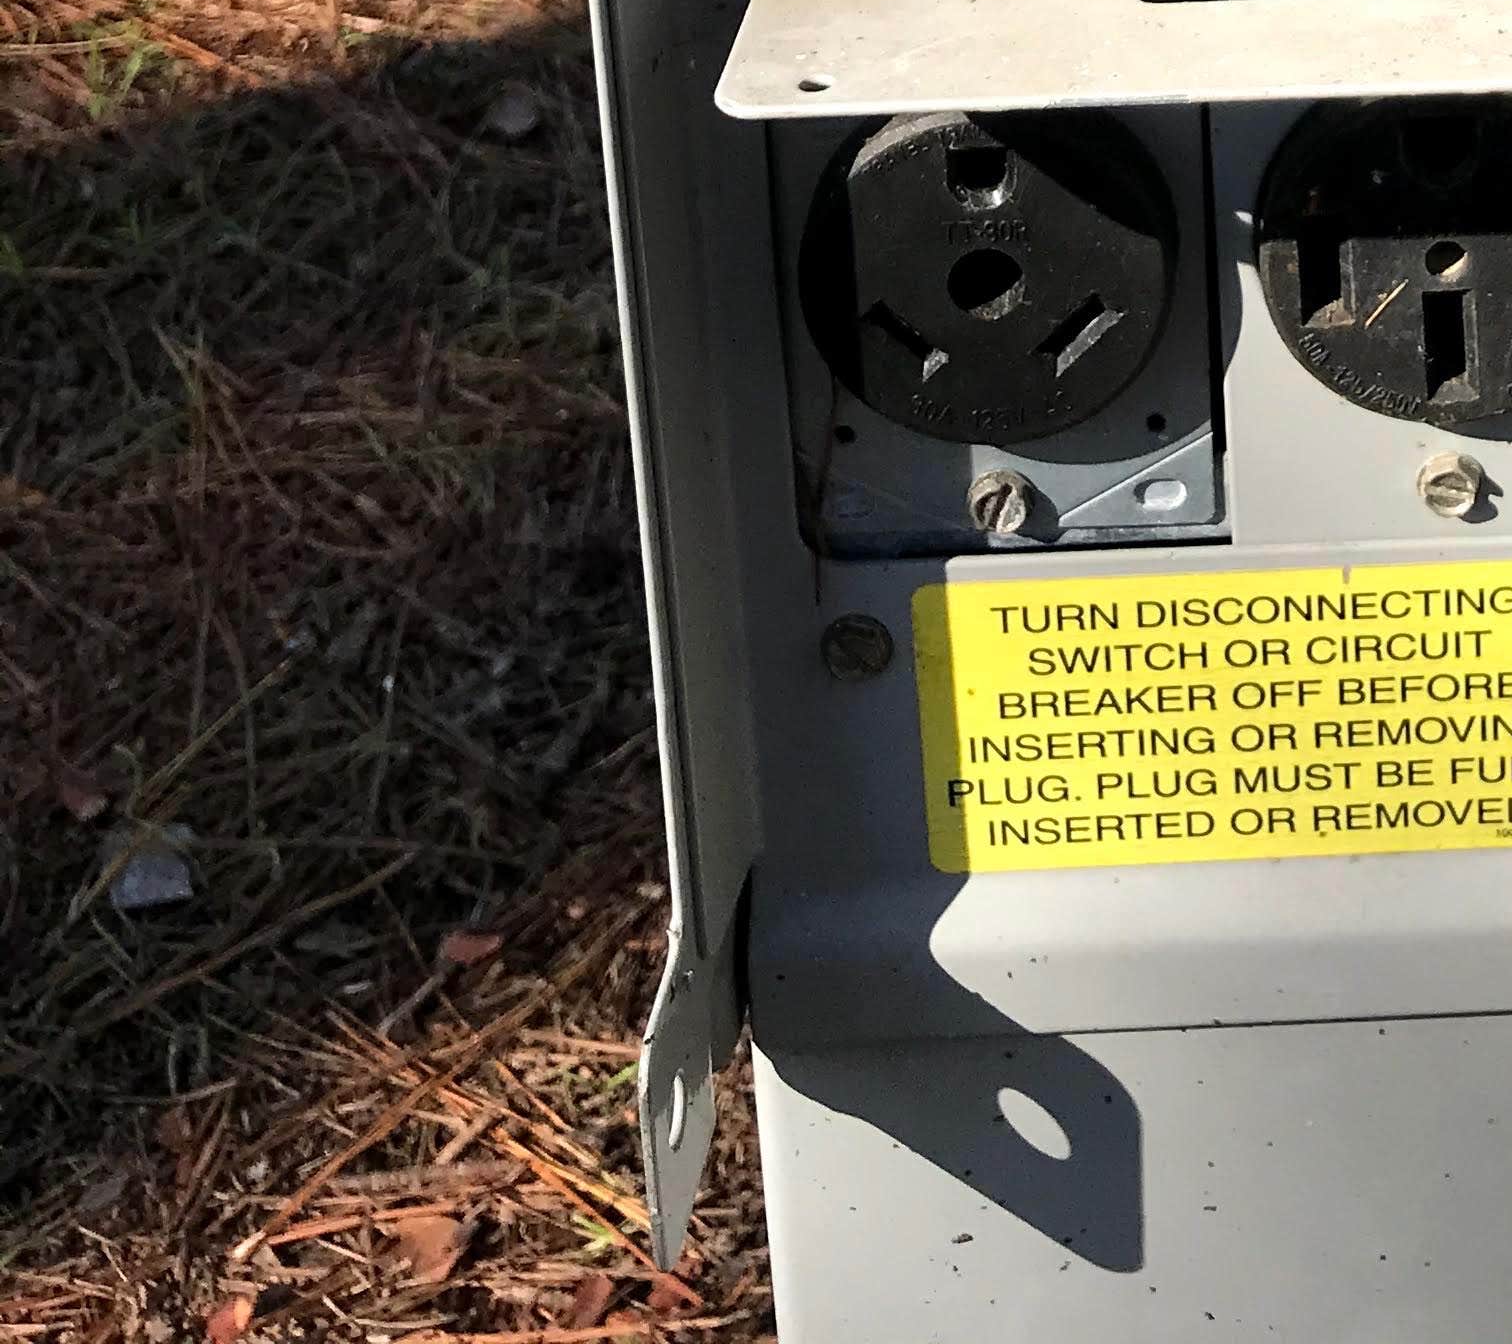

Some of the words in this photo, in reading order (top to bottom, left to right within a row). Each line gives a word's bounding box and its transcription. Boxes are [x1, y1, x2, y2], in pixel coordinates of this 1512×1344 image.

[990, 602, 1120, 635] TURN
[1027, 640, 1209, 677] SWITCH
[1223, 638, 1291, 668] OR
[1305, 629, 1493, 664] CIRCUIT
[998, 683, 1218, 720] BREAKER
[1232, 679, 1323, 710] OFF
[968, 725, 1216, 764] INSERTING
[1230, 723, 1298, 753] OR
[947, 774, 1082, 808] PLUG.
[1096, 768, 1219, 801] PLUG
[1233, 762, 1362, 795] MUST
[1376, 758, 1435, 789] BE
[989, 810, 1216, 847] INSERTED
[1229, 806, 1297, 836] OR
